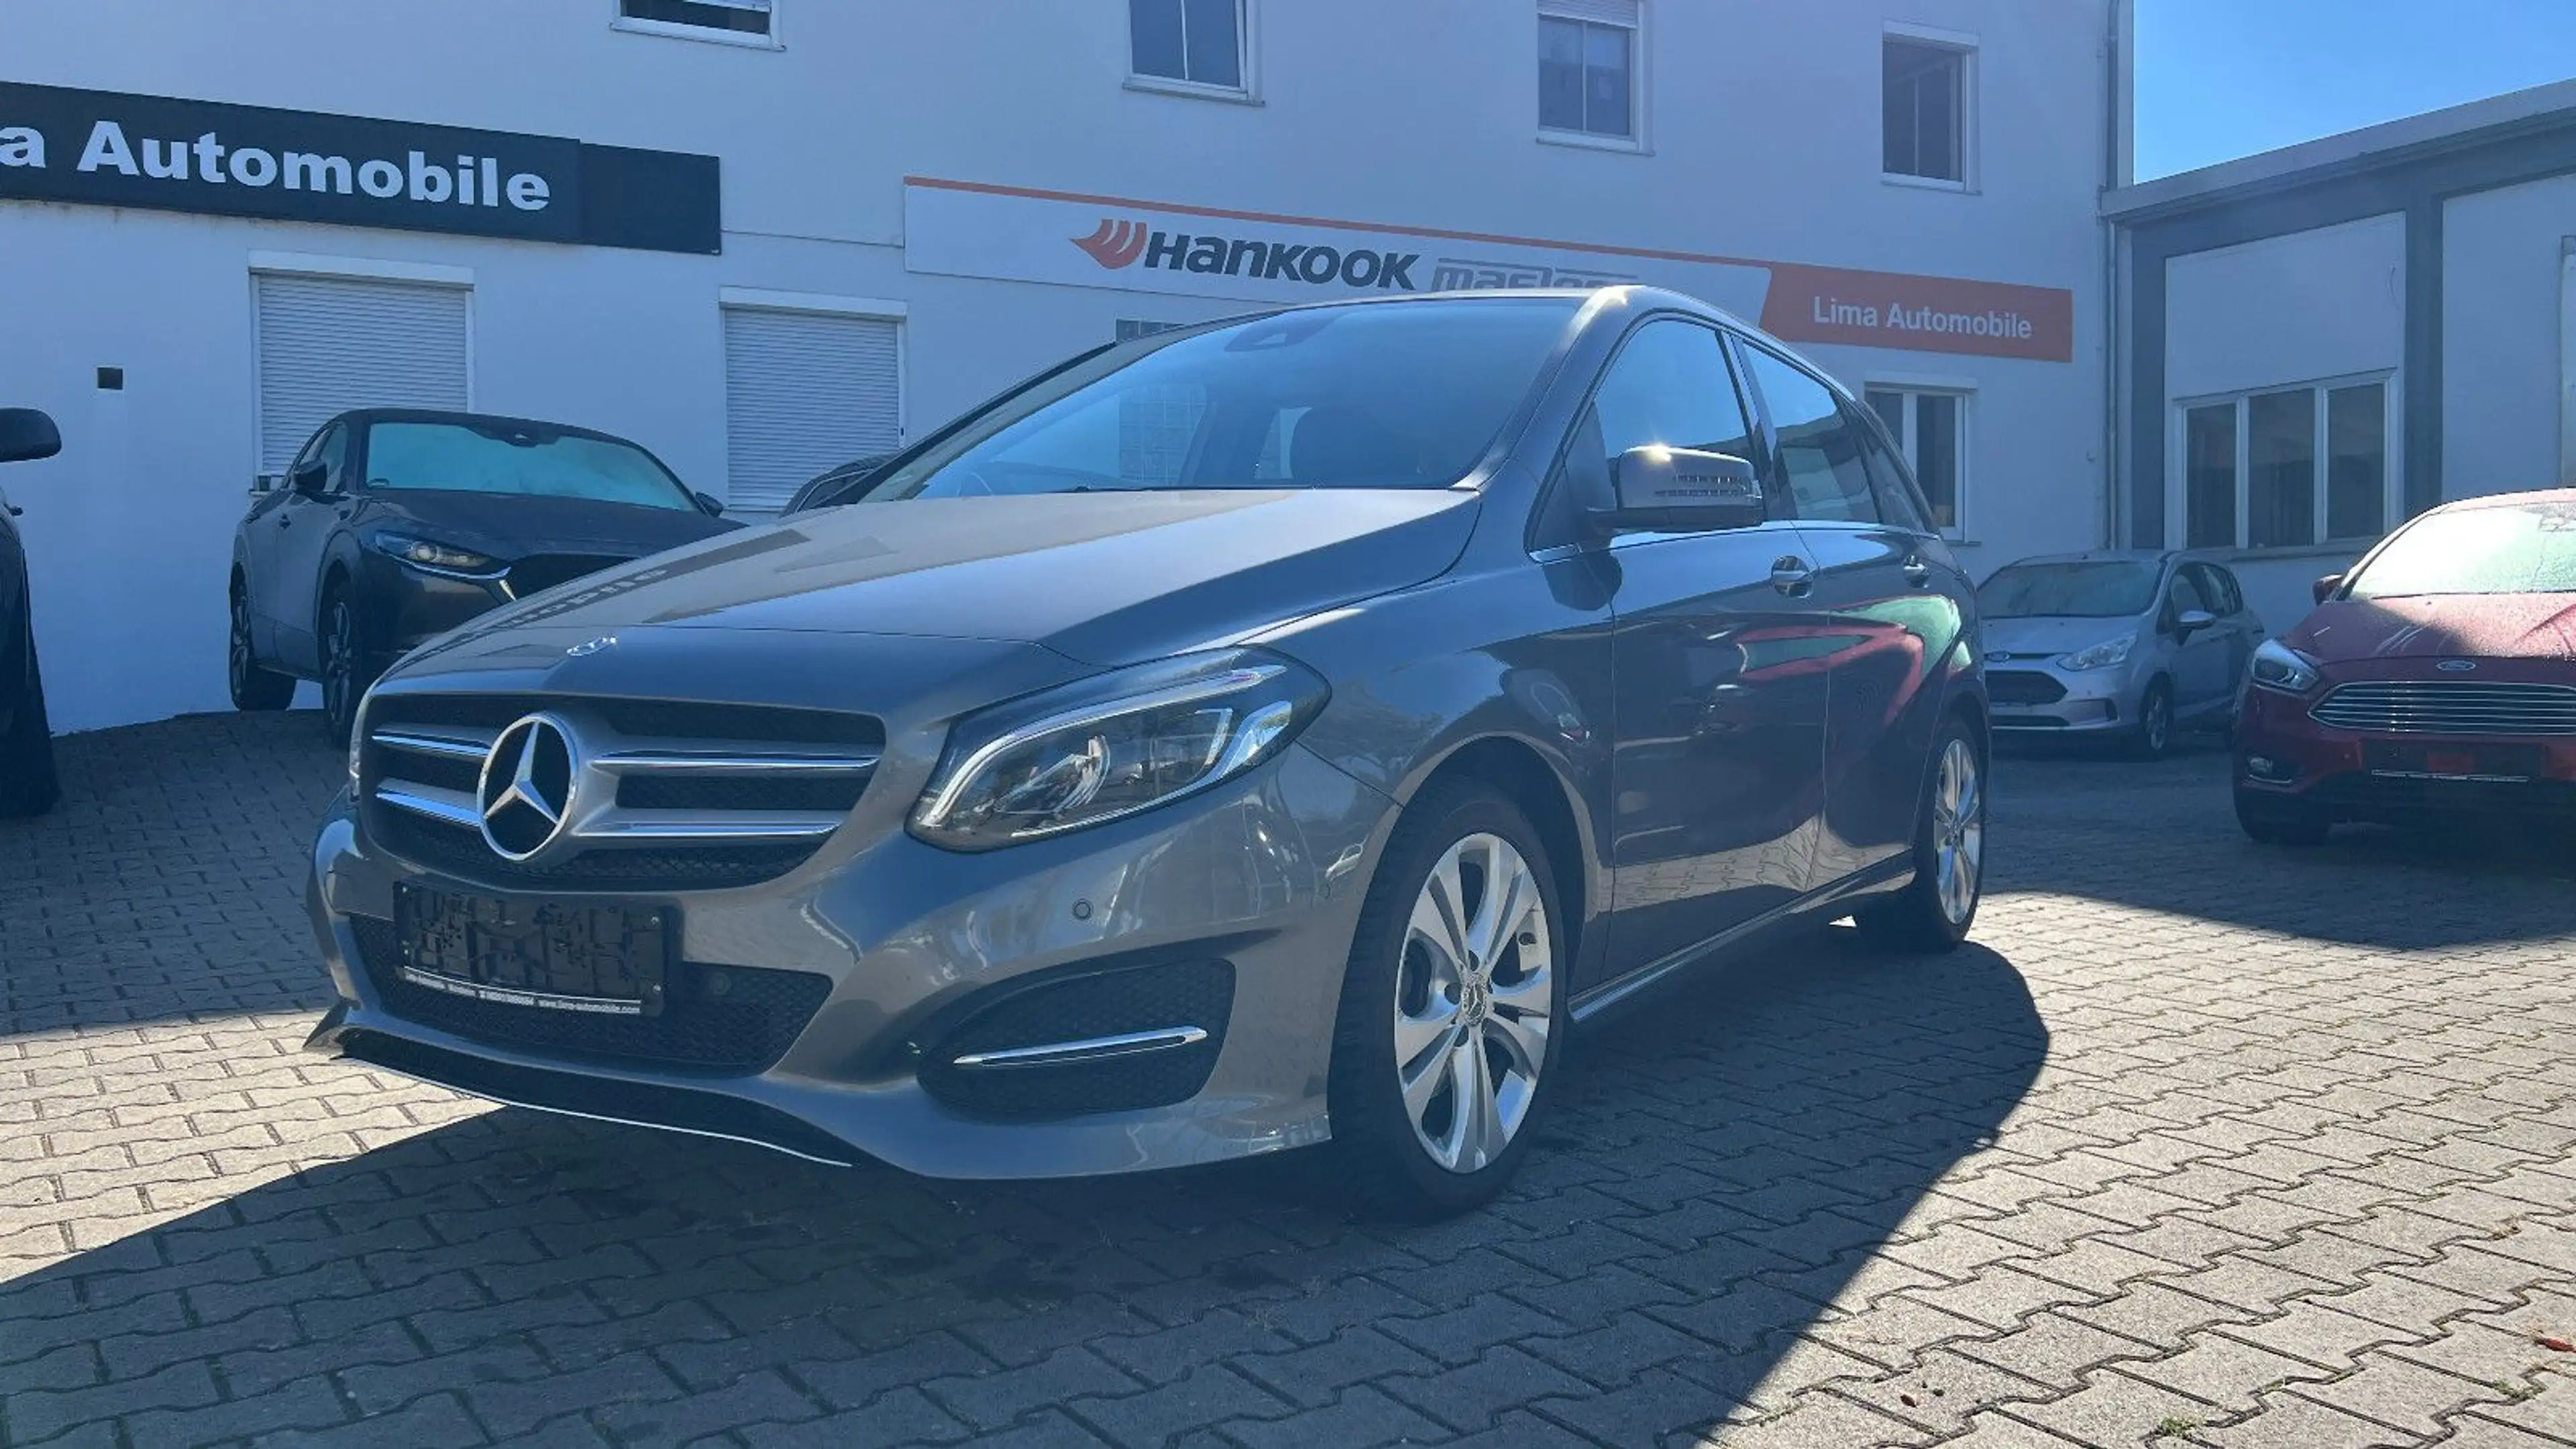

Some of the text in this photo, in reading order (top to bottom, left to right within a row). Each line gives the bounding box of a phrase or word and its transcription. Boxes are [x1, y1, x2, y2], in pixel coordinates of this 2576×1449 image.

[76, 120, 550, 211] Automobile
[1814, 296, 2033, 339] Lima Automobile
